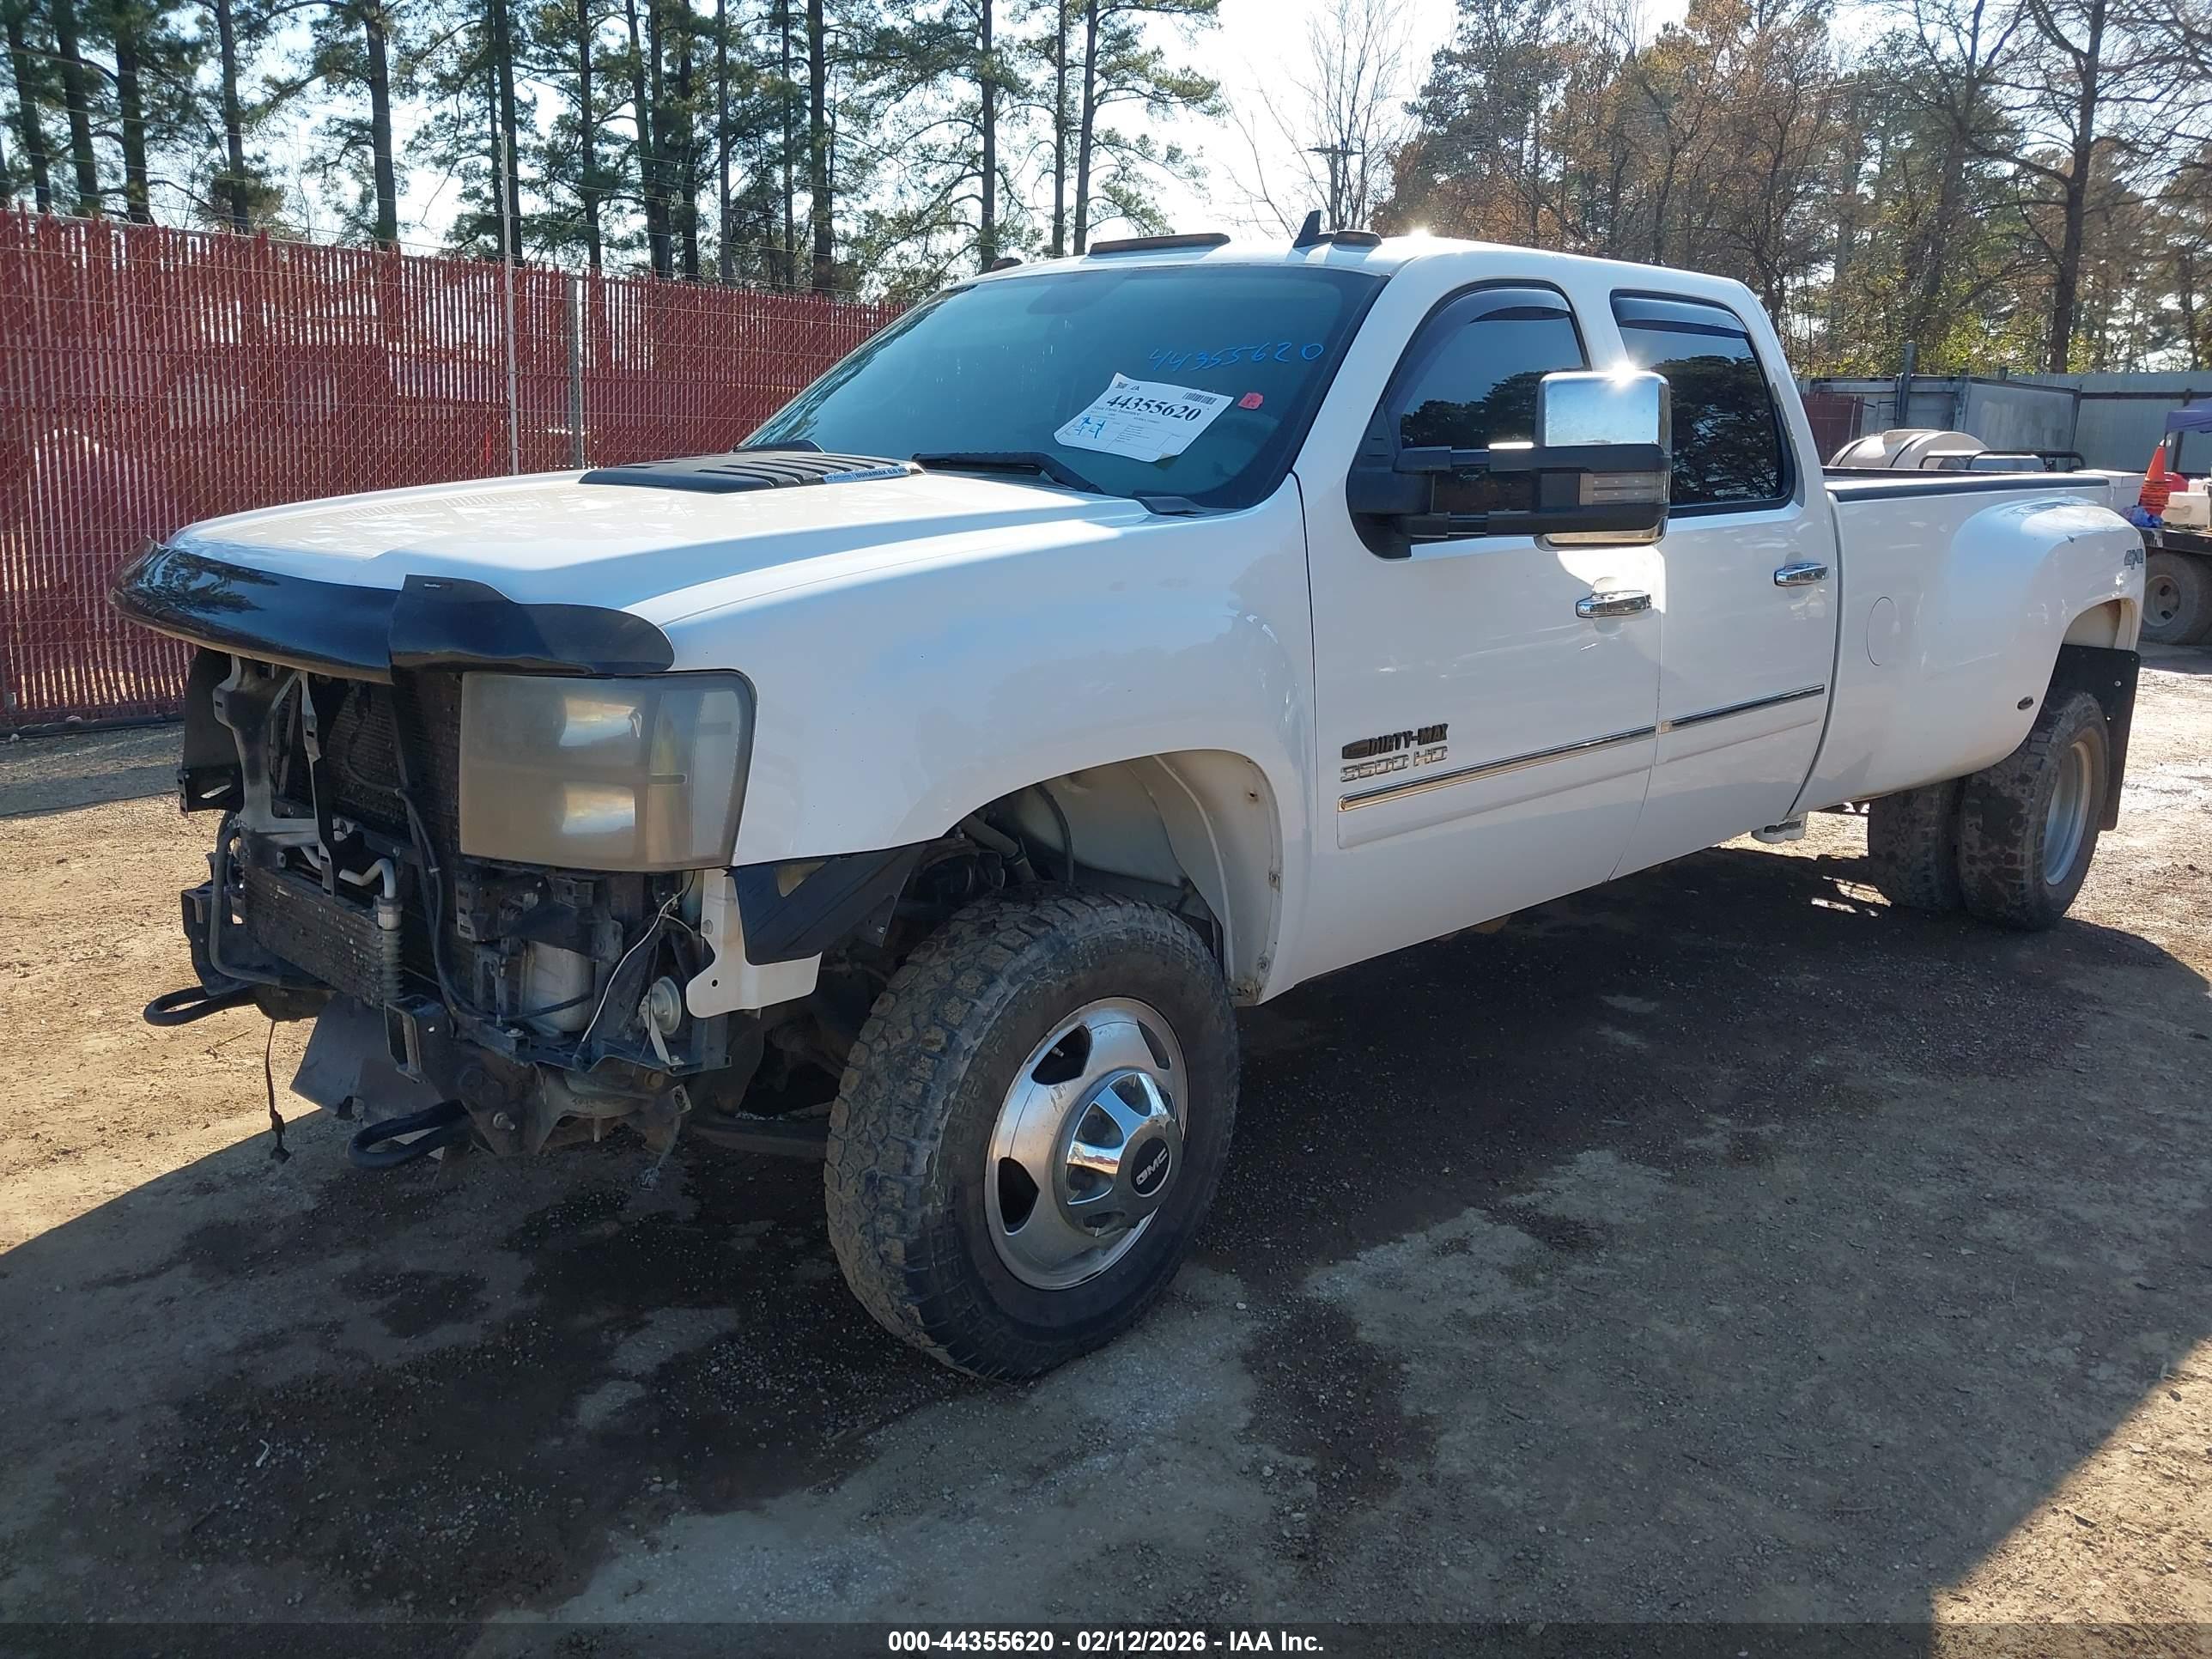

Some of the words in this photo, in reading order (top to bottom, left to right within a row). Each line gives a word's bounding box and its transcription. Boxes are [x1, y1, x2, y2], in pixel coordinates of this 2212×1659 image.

[1149, 343, 1324, 371] 44355620
[1106, 394, 1202, 422] 44355620
[1368, 723, 1449, 757] DIRTY-MAX
[1340, 754, 1409, 782] 3500
[1414, 745, 1449, 767] HD
[1135, 1147, 1169, 1186] GMC
